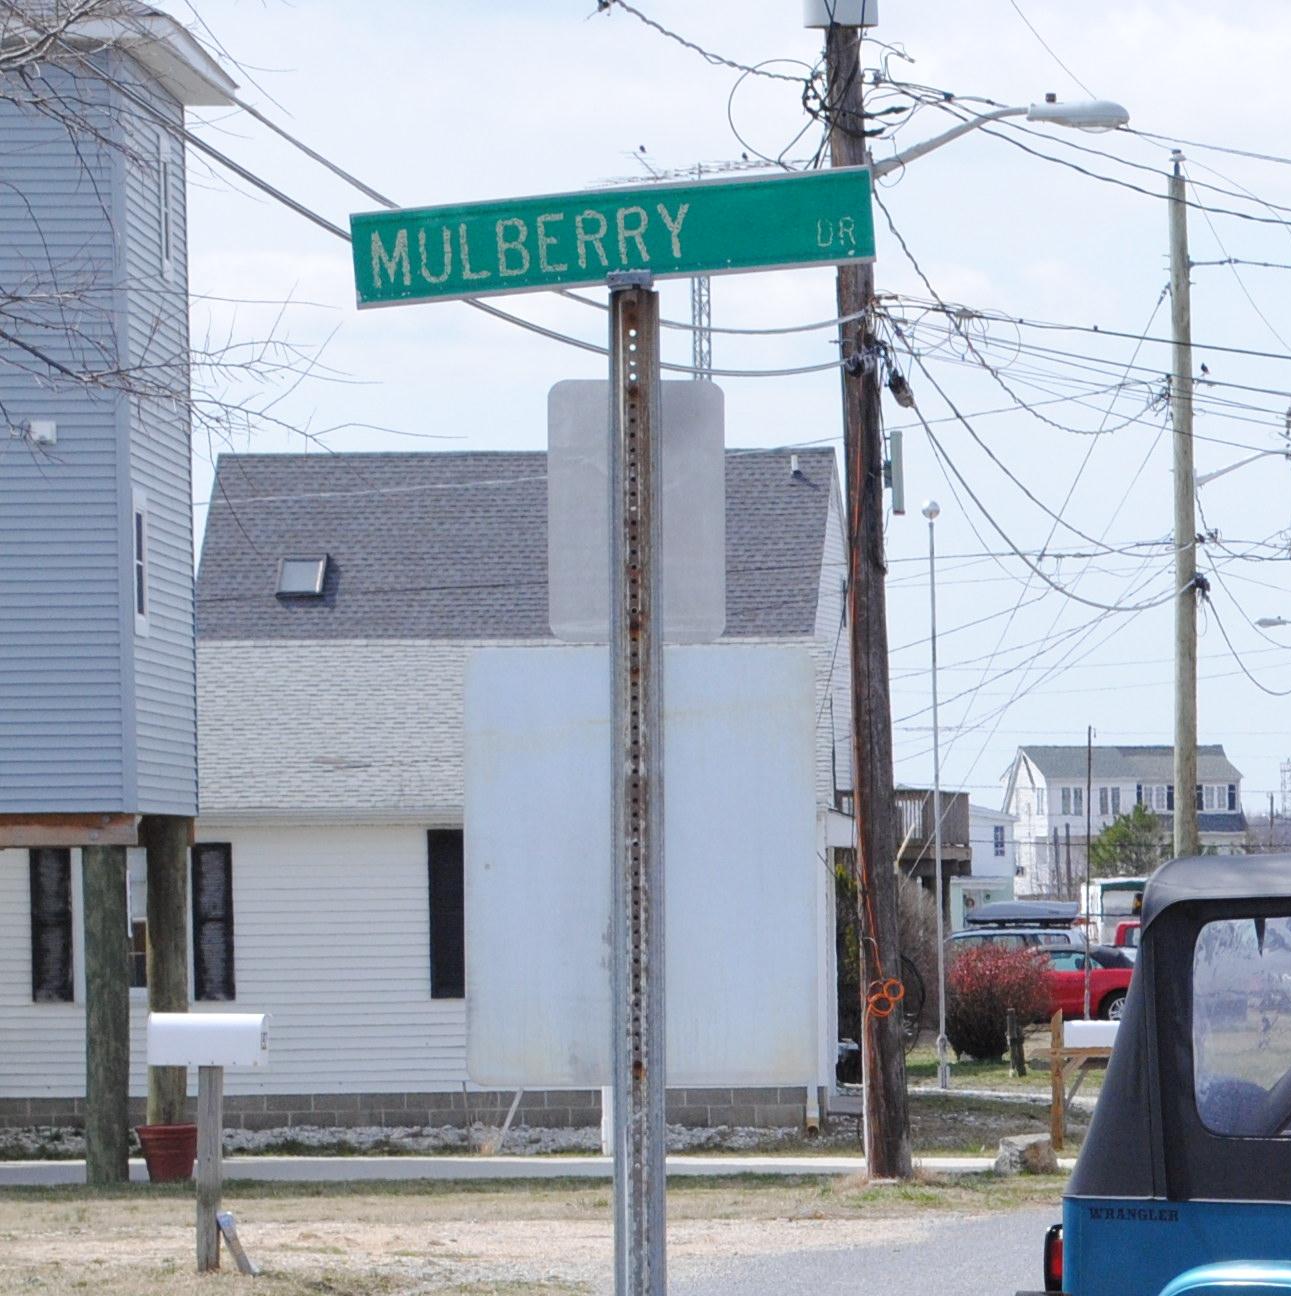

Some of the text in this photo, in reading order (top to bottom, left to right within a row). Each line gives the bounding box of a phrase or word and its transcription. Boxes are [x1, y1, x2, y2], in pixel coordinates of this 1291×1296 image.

[369, 203, 856, 288] MULBERRY DR
[1089, 1207, 1179, 1222] WRANGLER
